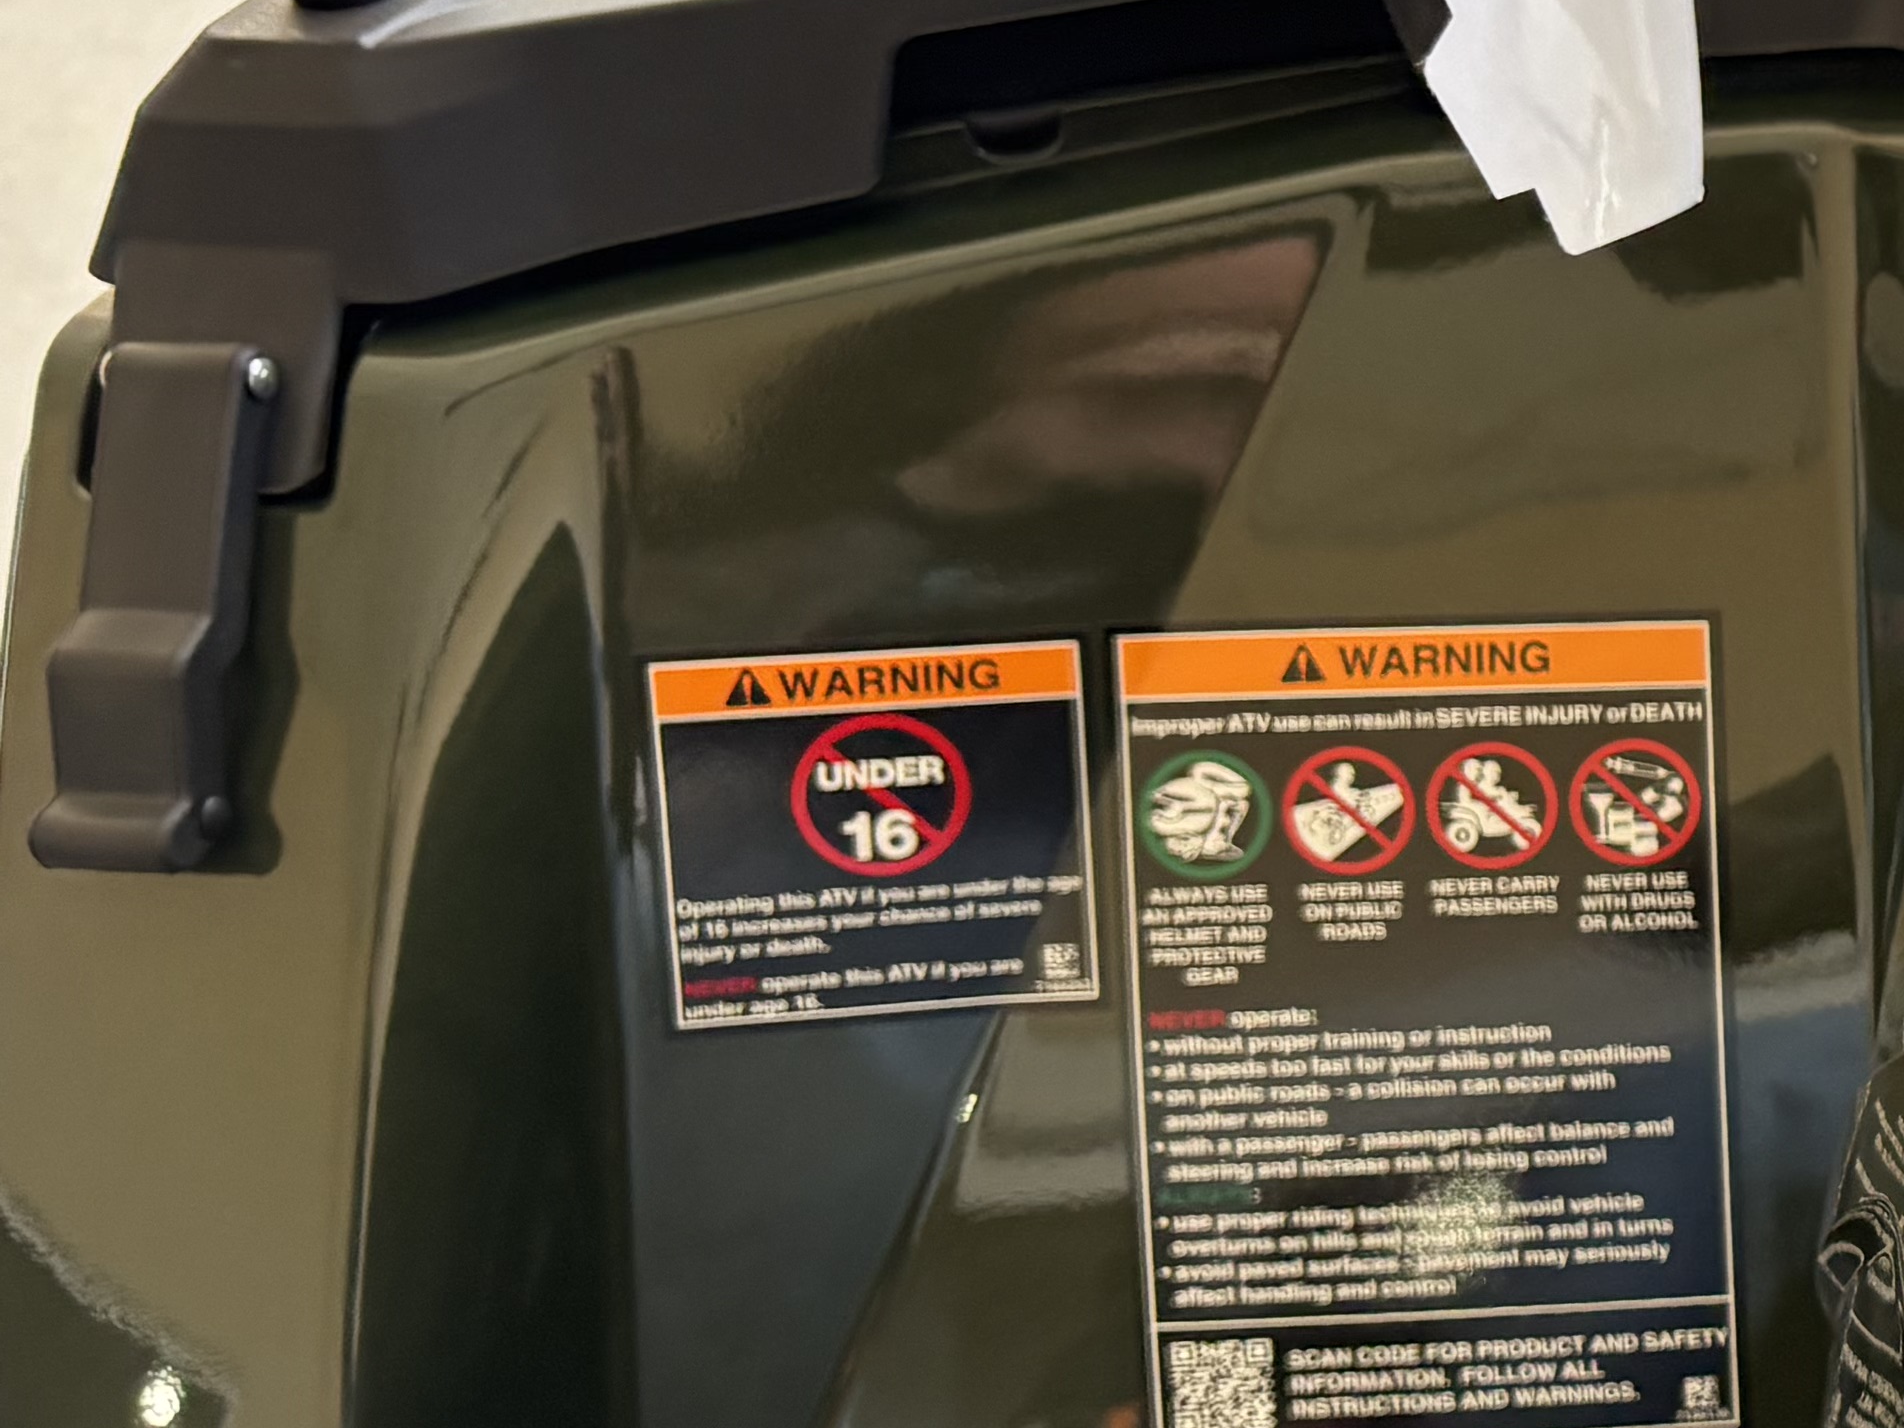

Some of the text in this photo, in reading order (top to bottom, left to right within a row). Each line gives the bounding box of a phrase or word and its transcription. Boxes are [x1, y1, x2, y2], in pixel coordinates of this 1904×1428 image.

[1338, 641, 1552, 677] WARNING
[778, 659, 1000, 701] WARNING
[1436, 706, 1522, 729] SEVERE
[1525, 704, 1603, 726] INJURY
[1630, 702, 1702, 723] DEATH
[815, 755, 946, 792] UNDER
[840, 809, 919, 861] 16
[1430, 875, 1560, 896] NEVER CARRY
[1585, 873, 1647, 891] NEVER
[1433, 895, 1558, 917] PASSENGERS
[1287, 1327, 1729, 1370] SCAN CODE FOR PRODUCT AND SAFETY
[1461, 1361, 1558, 1388] FOLLOW
[1460, 1386, 1509, 1411] AND
